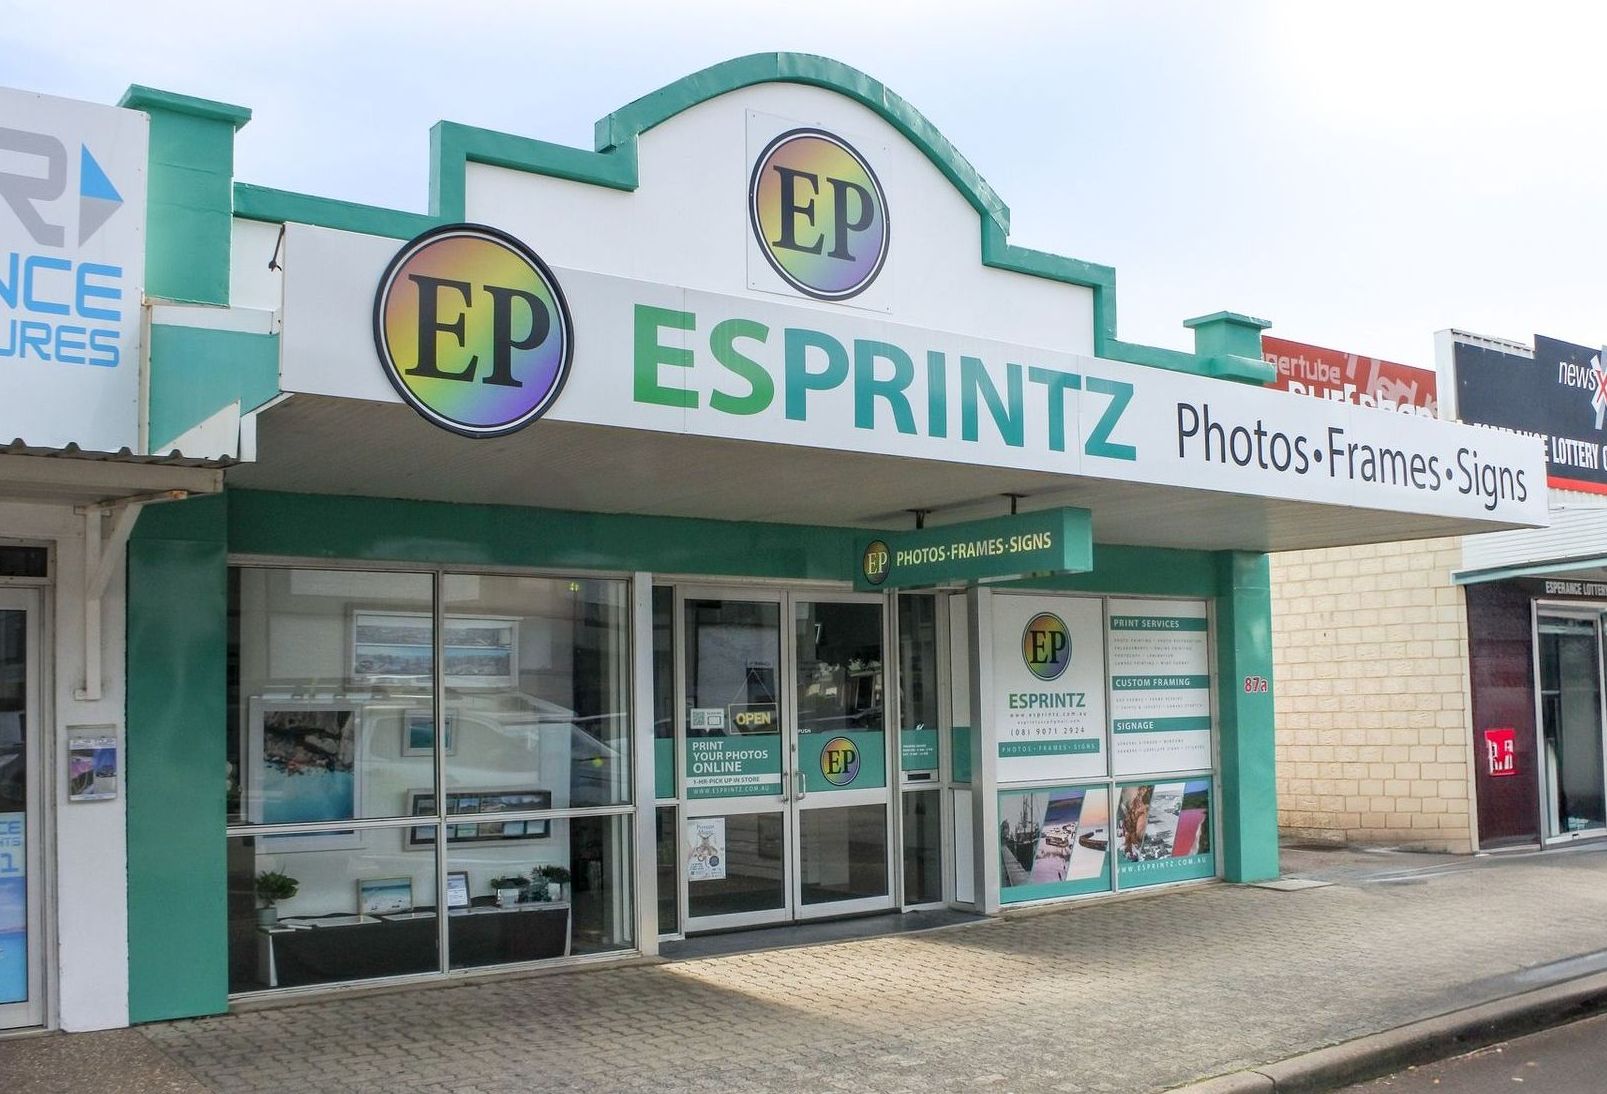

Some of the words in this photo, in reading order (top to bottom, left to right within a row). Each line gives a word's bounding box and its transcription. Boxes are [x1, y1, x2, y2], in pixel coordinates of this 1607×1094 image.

[772, 165, 874, 261] EP
[405, 273, 549, 387] EP
[633, 302, 1136, 461] ESPRINTZ
[1551, 436, 1600, 470] LOTTERY
[866, 552, 888, 574] EP
[1545, 581, 1582, 595] ESPERANCE
[1113, 619, 1139, 628] PRINT
[1141, 620, 1180, 628] SERVICES
[1030, 630, 1066, 663] EP
[1115, 679, 1151, 688] CUSTOM
[1153, 678, 1191, 686] FRAMING
[1244, 676, 1269, 693] 87a
[1008, 693, 1086, 709] ESPRINTZ
[736, 711, 771, 725] OPEN
[1117, 721, 1154, 731] SIGNAGE
[692, 741, 724, 751] PRINT
[693, 752, 724, 761] YOUR
[725, 750, 769, 760] PHOTOS
[827, 750, 857, 774] EP
[693, 761, 742, 774] ONLINE
